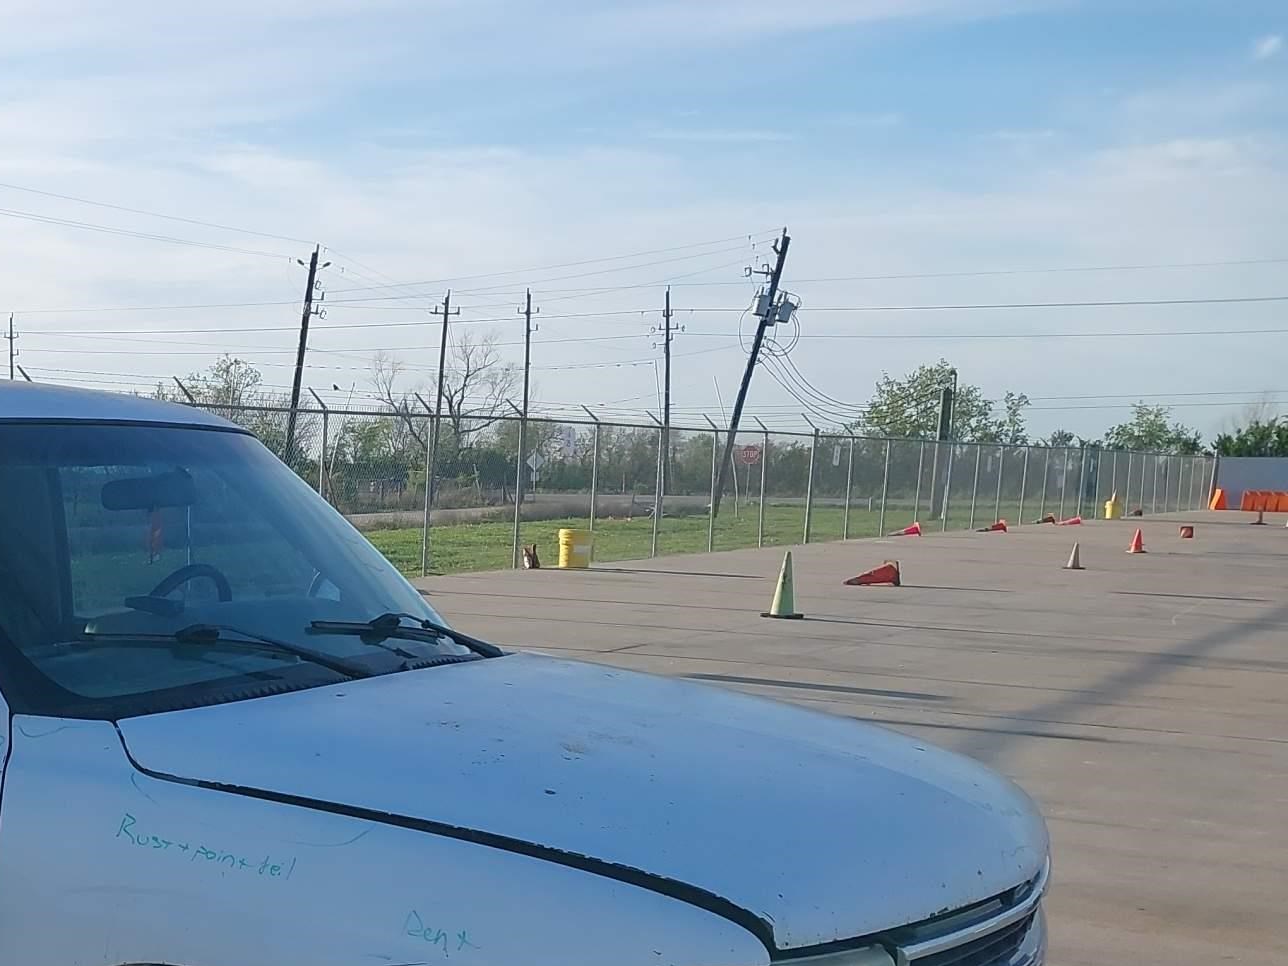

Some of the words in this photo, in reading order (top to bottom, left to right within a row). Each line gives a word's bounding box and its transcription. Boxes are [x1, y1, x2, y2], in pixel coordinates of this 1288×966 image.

[743, 450, 758, 458] STOP
[115, 812, 173, 849] Rust
[401, 909, 481, 958] Dent
